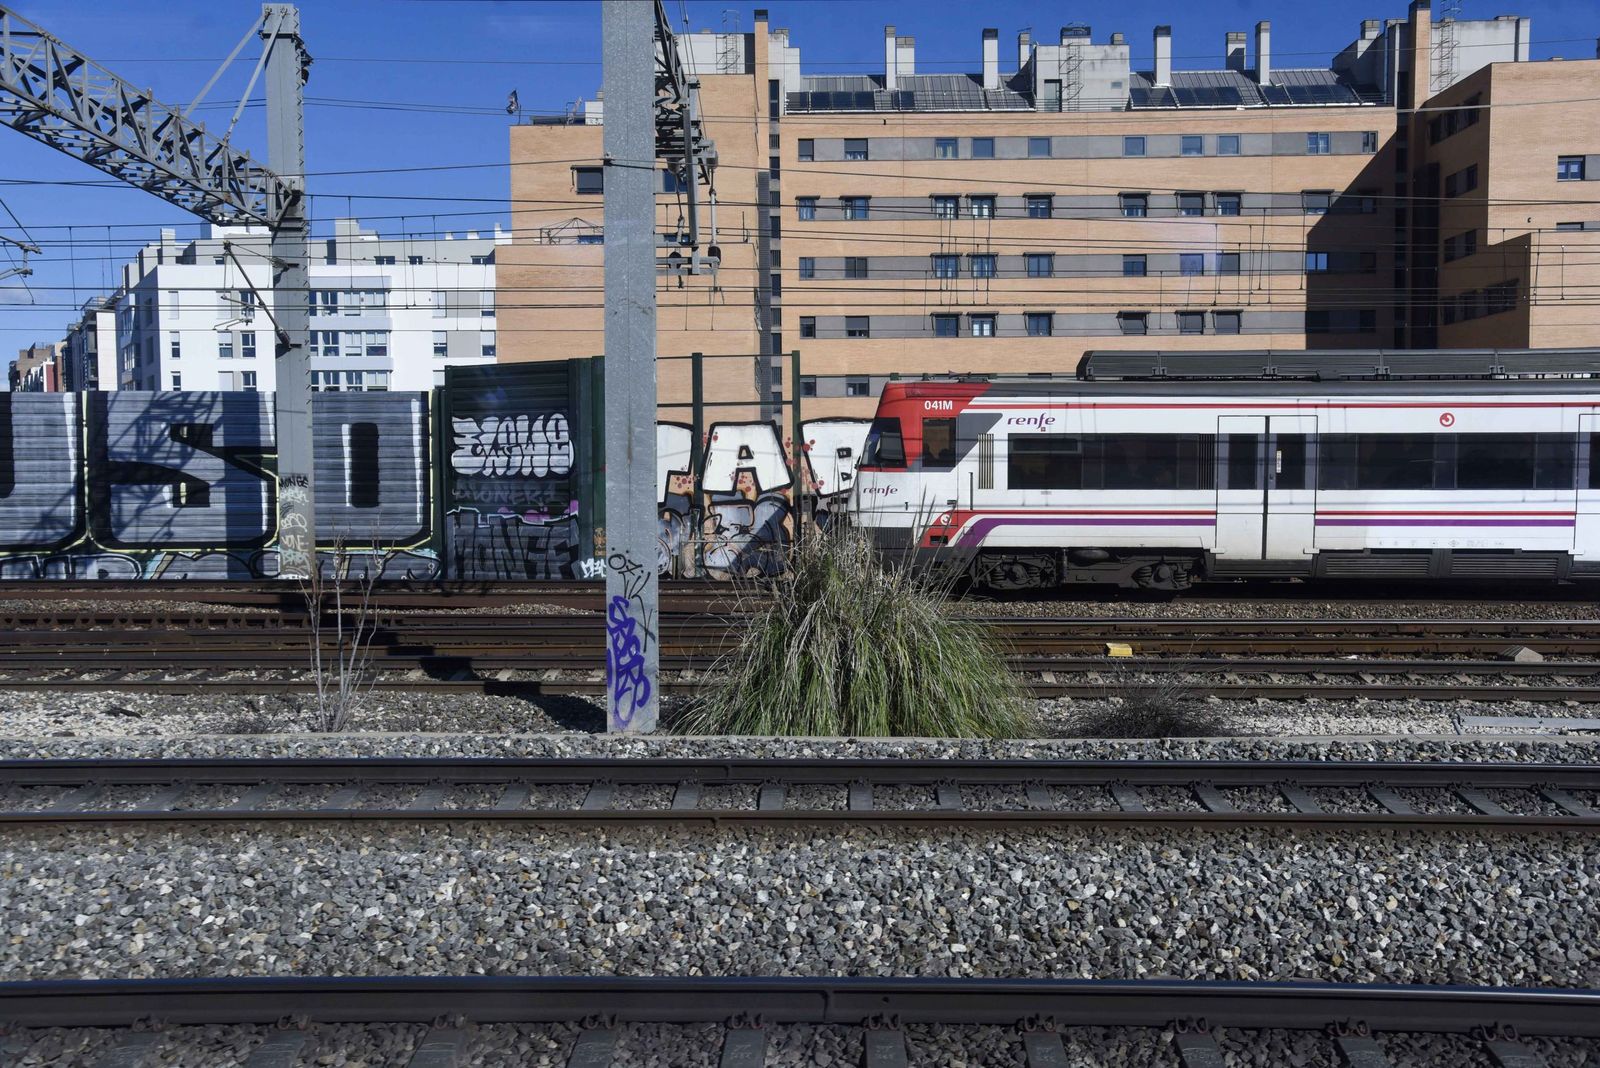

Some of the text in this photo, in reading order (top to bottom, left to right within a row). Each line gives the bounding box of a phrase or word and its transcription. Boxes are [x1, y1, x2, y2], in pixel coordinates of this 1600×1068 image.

[924, 400, 953, 411] 041M
[1007, 411, 1056, 429] renfe
[862, 484, 898, 497] renfe
